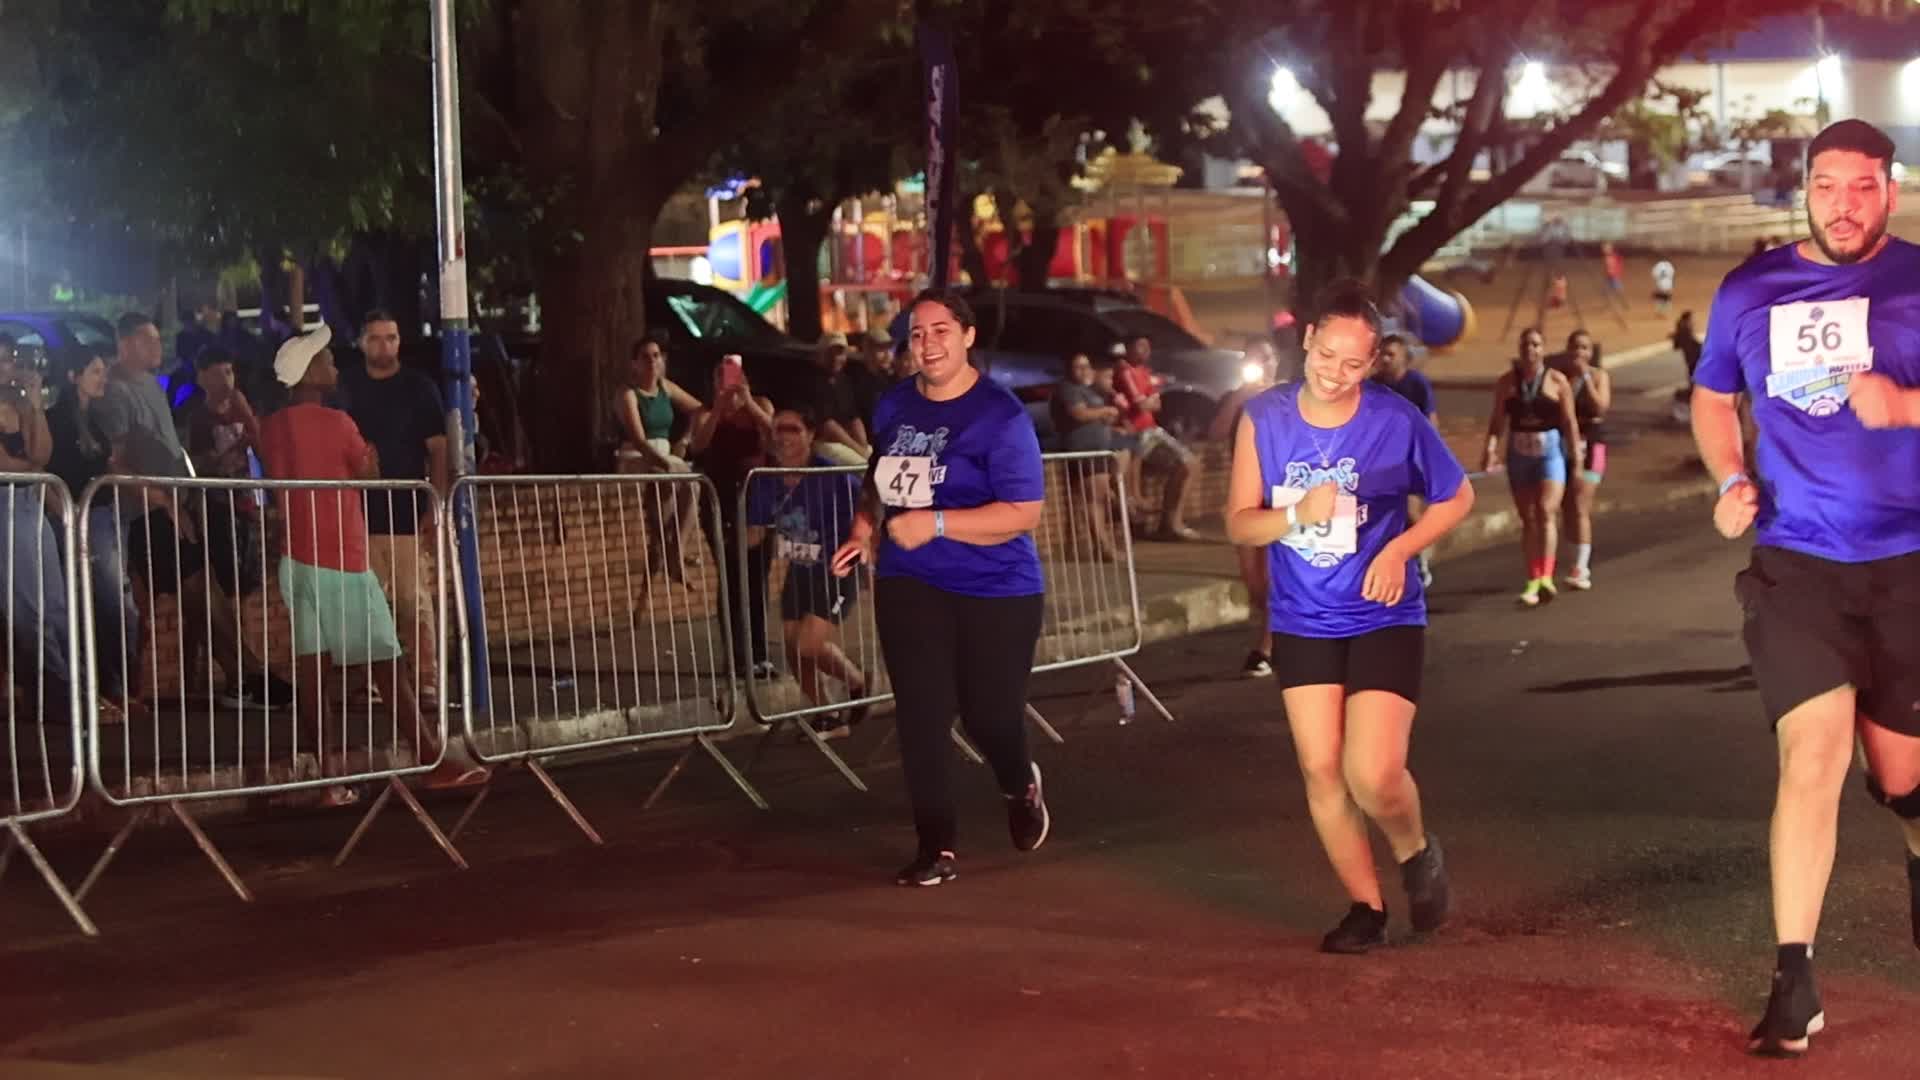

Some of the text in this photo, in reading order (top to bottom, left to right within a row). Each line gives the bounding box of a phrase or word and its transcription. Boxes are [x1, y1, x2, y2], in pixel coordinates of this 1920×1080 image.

[1797, 321, 1842, 353] 56
[889, 472, 920, 496] 47
[1299, 517, 1333, 538] 9
